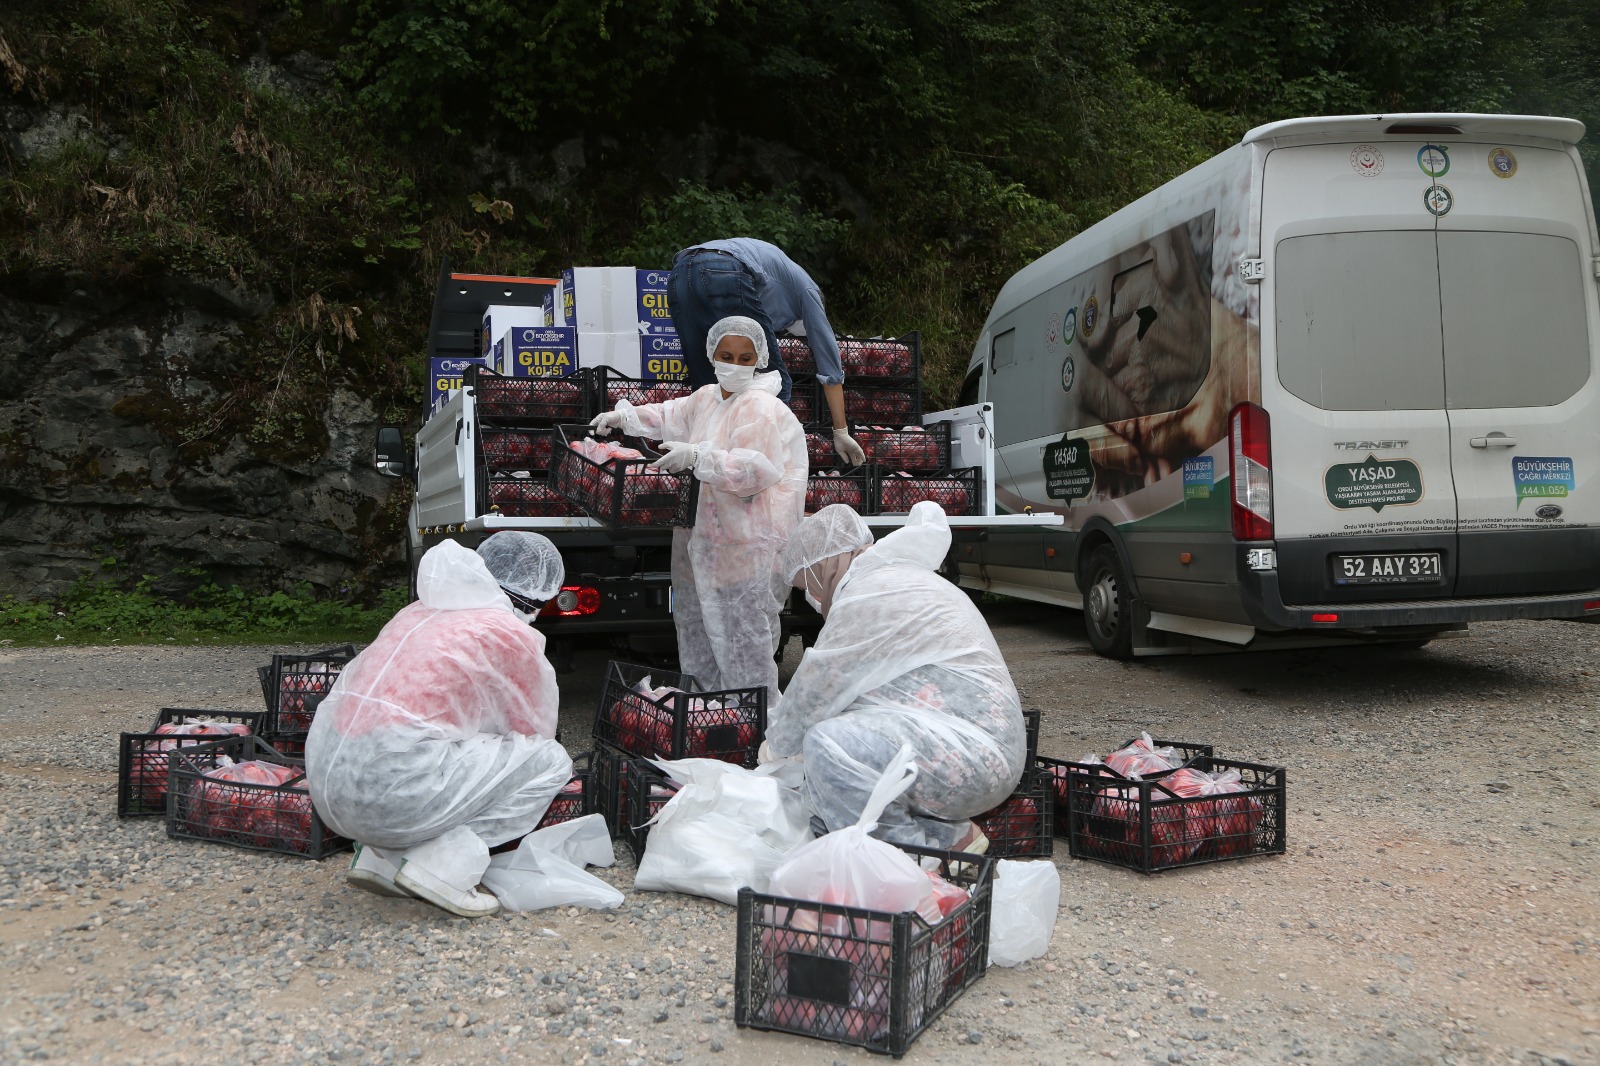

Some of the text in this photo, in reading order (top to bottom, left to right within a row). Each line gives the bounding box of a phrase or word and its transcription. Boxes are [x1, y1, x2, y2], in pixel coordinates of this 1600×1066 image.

[651, 309, 671, 318] KOL
[518, 351, 571, 366] GIDA
[1054, 446, 1078, 468] YAŞAD
[1517, 460, 1571, 473] BÜYÜKŞEHİR
[1348, 466, 1396, 483] YAŞAD
[1518, 471, 1571, 482] ÇAĞRI MERKEZİ
[1521, 485, 1566, 495] 444 1 052
[1343, 556, 1439, 577] 52 AAY 321
